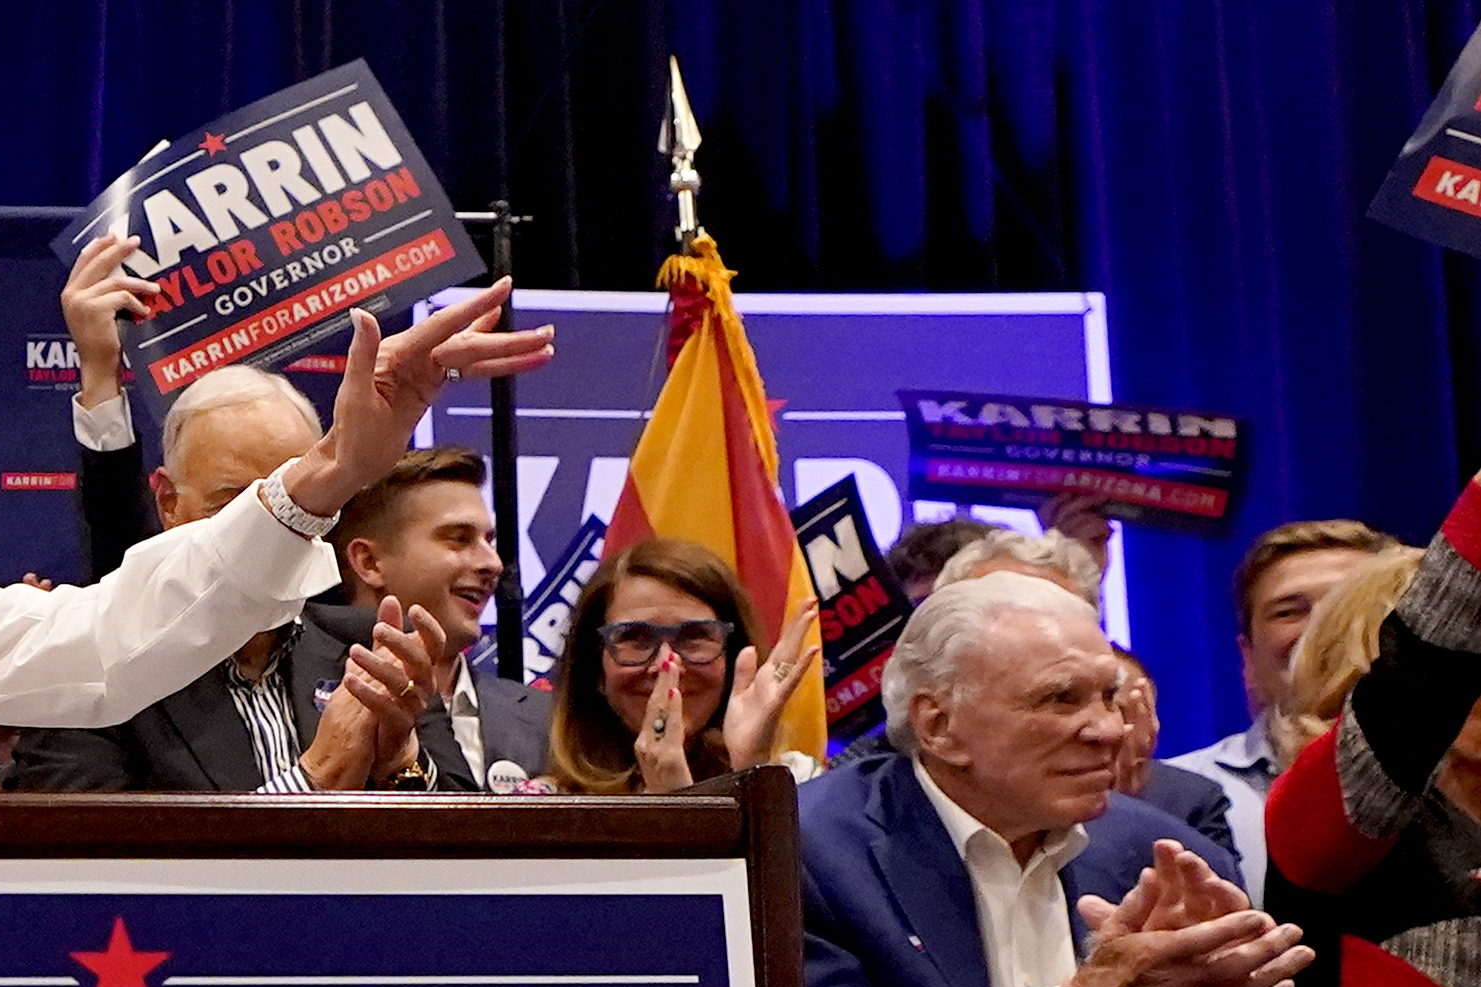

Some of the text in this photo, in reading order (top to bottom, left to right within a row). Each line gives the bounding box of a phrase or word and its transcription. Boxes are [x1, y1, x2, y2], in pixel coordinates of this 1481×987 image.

[133, 167, 421, 324] AYLOR ROBSON
[214, 236, 359, 316] GOVERNOR
[161, 241, 442, 383] KARRINFORARIZONA.COM
[917, 400, 1237, 438] KARRIN
